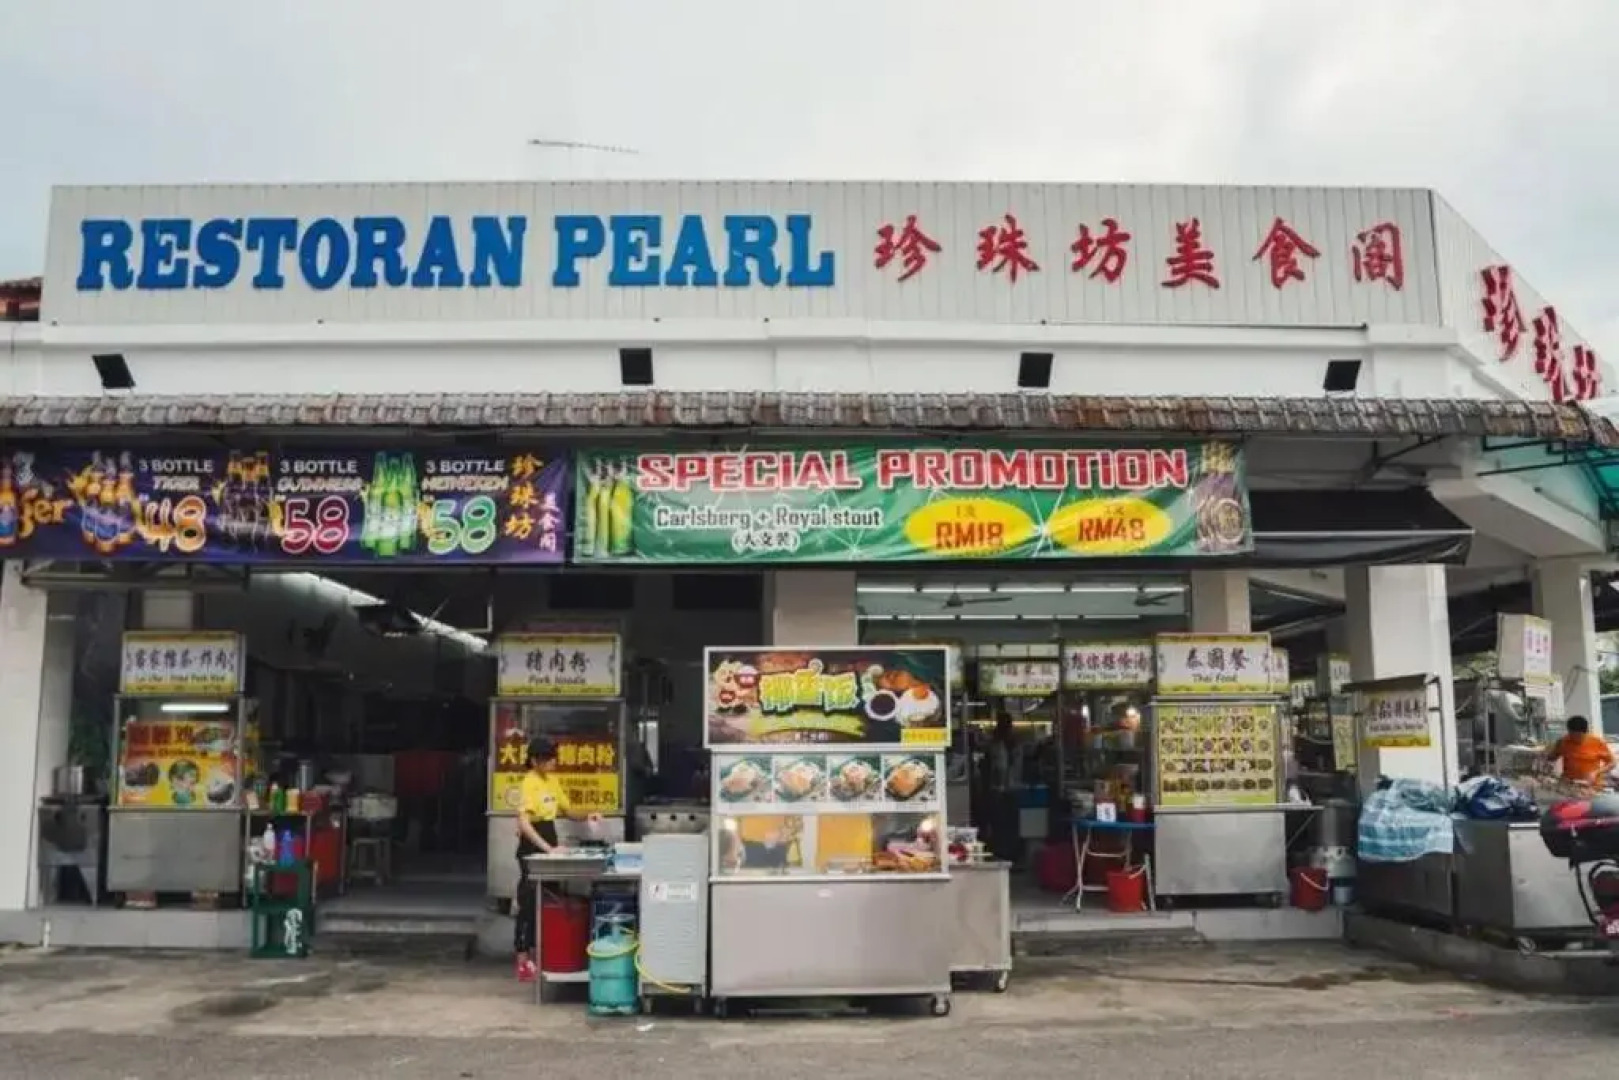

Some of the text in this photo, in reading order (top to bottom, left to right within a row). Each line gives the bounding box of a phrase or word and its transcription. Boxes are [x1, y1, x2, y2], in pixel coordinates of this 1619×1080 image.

[76, 214, 835, 291] RESTORAN PEARL
[139, 458, 214, 473] 3 BOTTLE
[280, 459, 358, 474] 3 BOTTLE
[426, 459, 506, 474] 3 BOTTLE
[636, 448, 1189, 491] SPECIAL PROMOTION
[280, 495, 349, 554] 58
[427, 495, 497, 555] 58
[655, 505, 752, 530] Carlsberg
[774, 503, 828, 532] Royal
[832, 506, 883, 528] stout
[1078, 518, 1146, 542] RM48
[935, 522, 1005, 549] RM18
